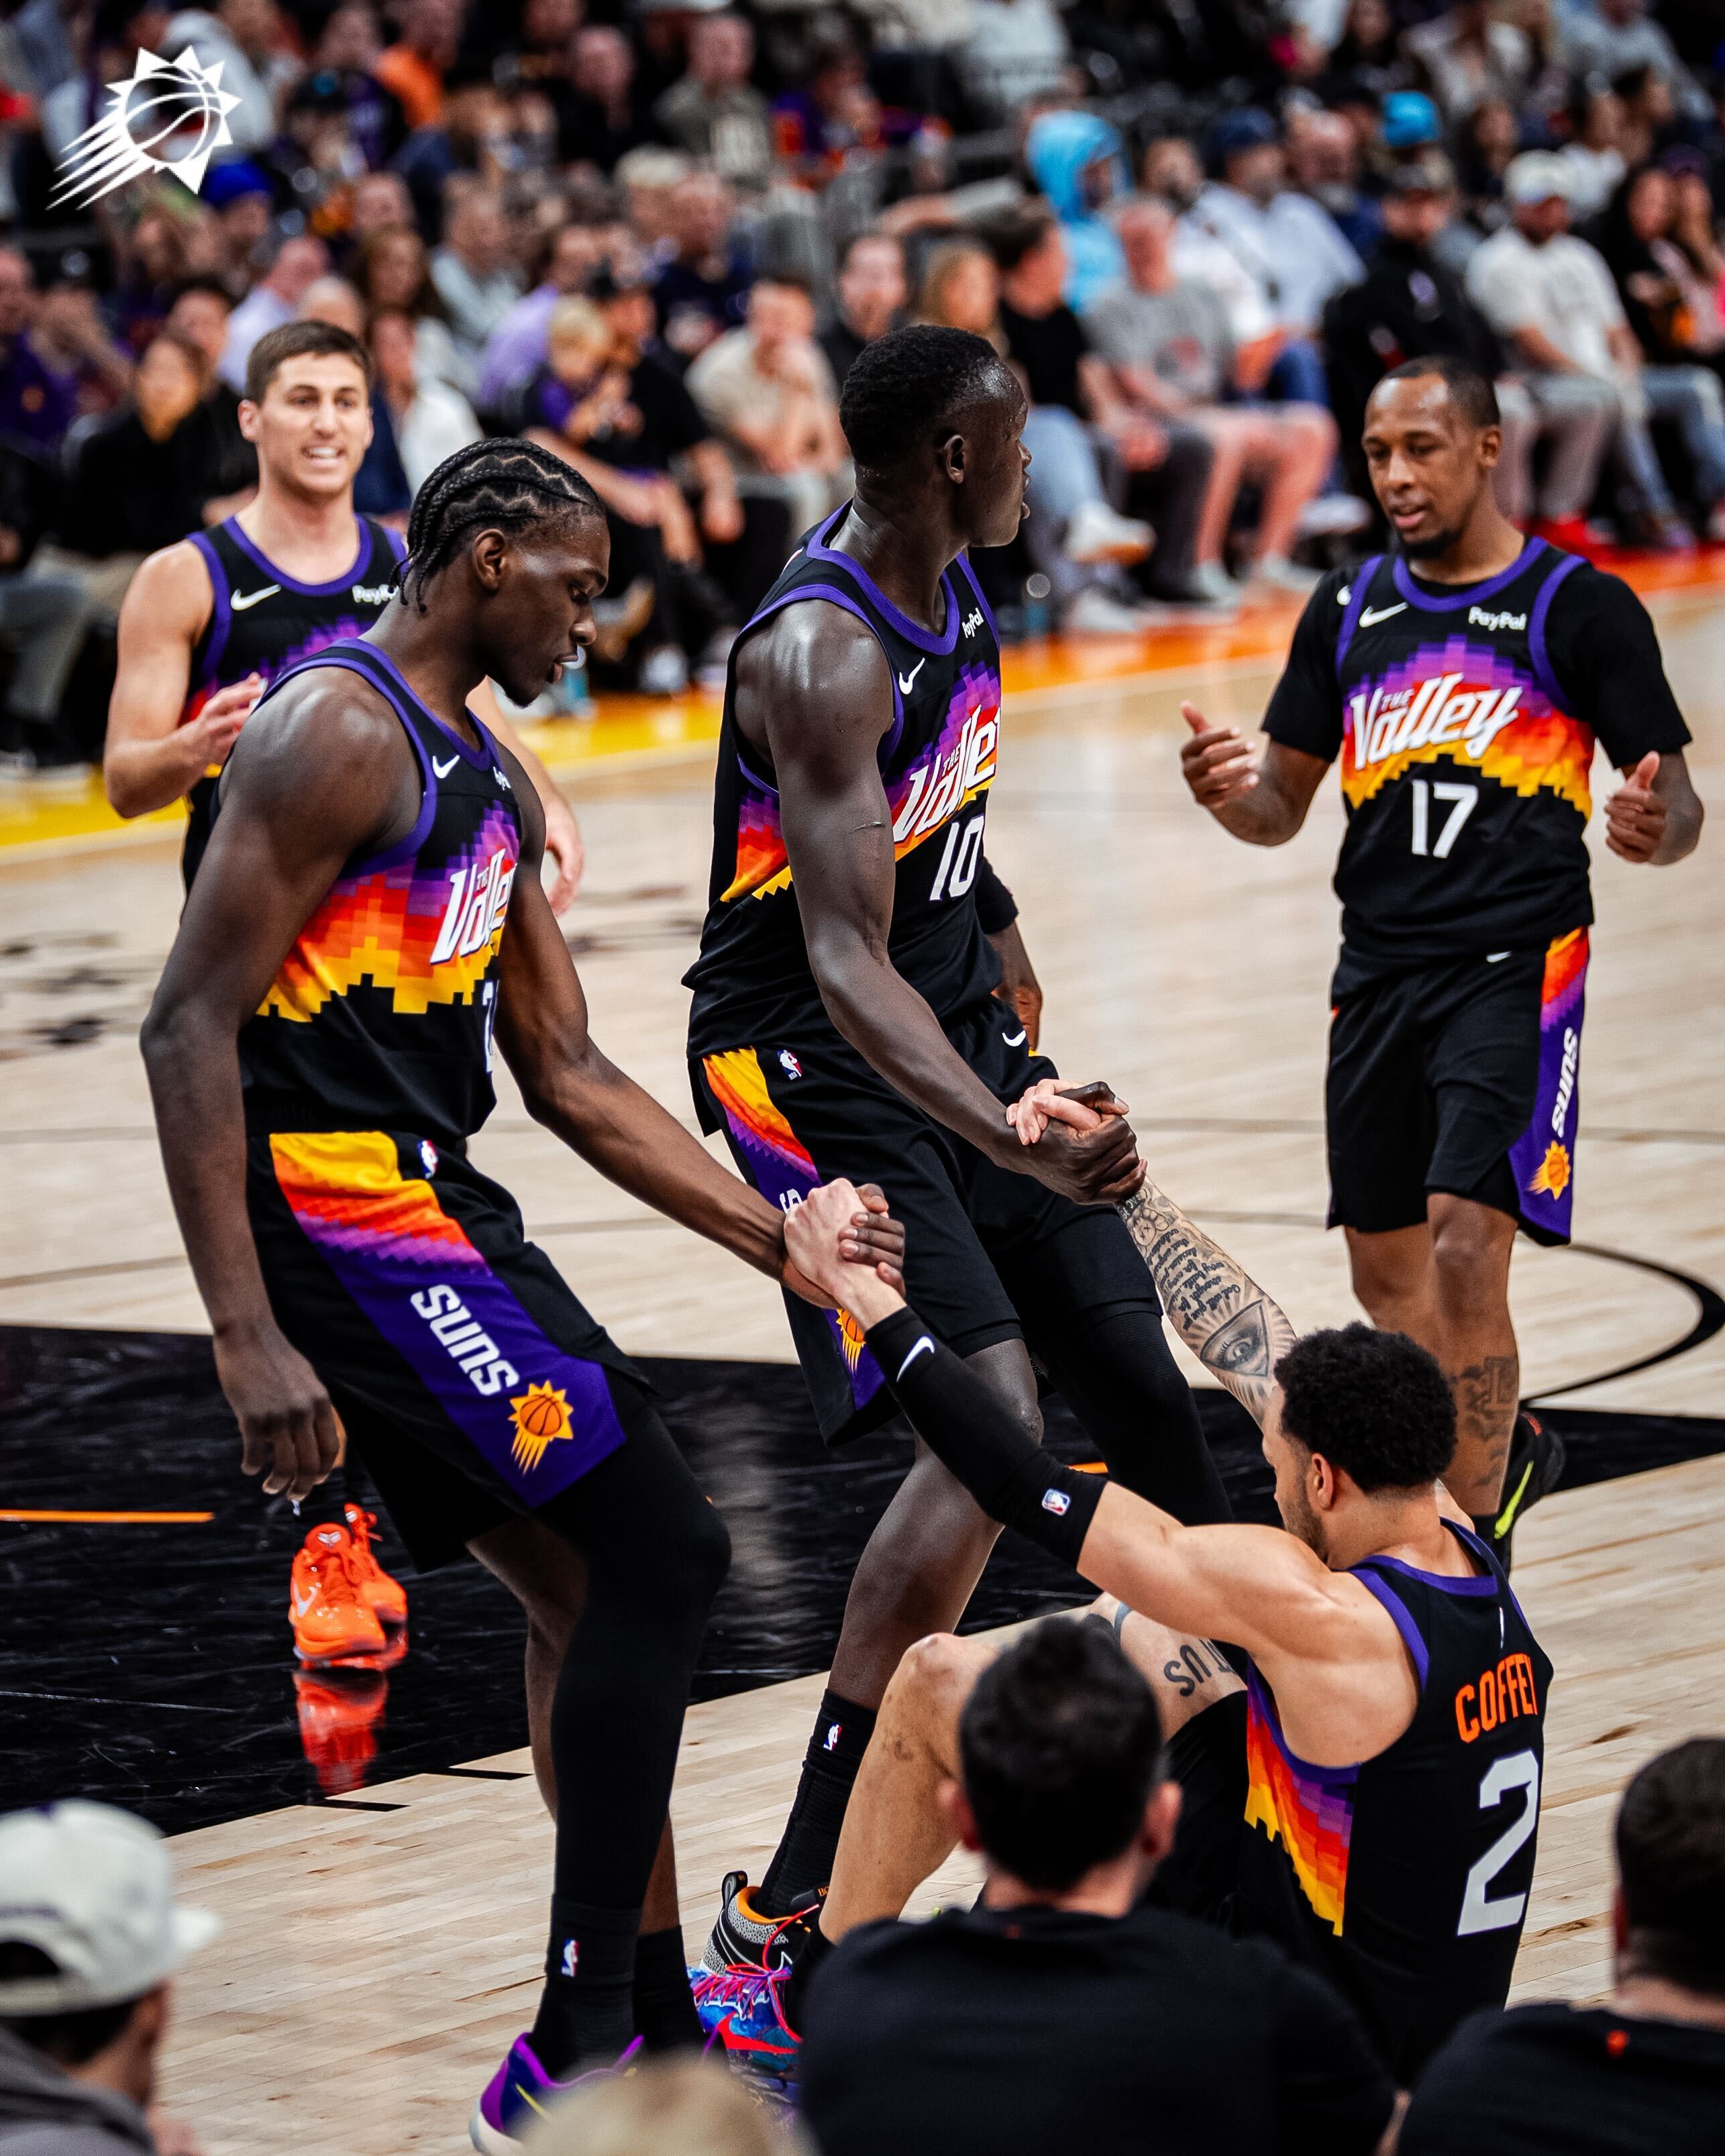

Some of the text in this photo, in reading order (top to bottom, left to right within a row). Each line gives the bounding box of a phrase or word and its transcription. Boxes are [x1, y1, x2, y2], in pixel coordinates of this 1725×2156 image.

[962, 607, 984, 639] PayPal
[1468, 606, 1527, 631] PayPal
[1350, 672, 1522, 771] Valley
[1381, 688, 1414, 712] THE
[893, 704, 1000, 843] Valle
[943, 750, 960, 777] THE
[929, 815, 984, 902] 10
[1412, 779, 1478, 859] 17
[1551, 1027, 1577, 1138] SUNS
[411, 1285, 519, 1396] SUNS
[1456, 1747, 1539, 1937] 2
